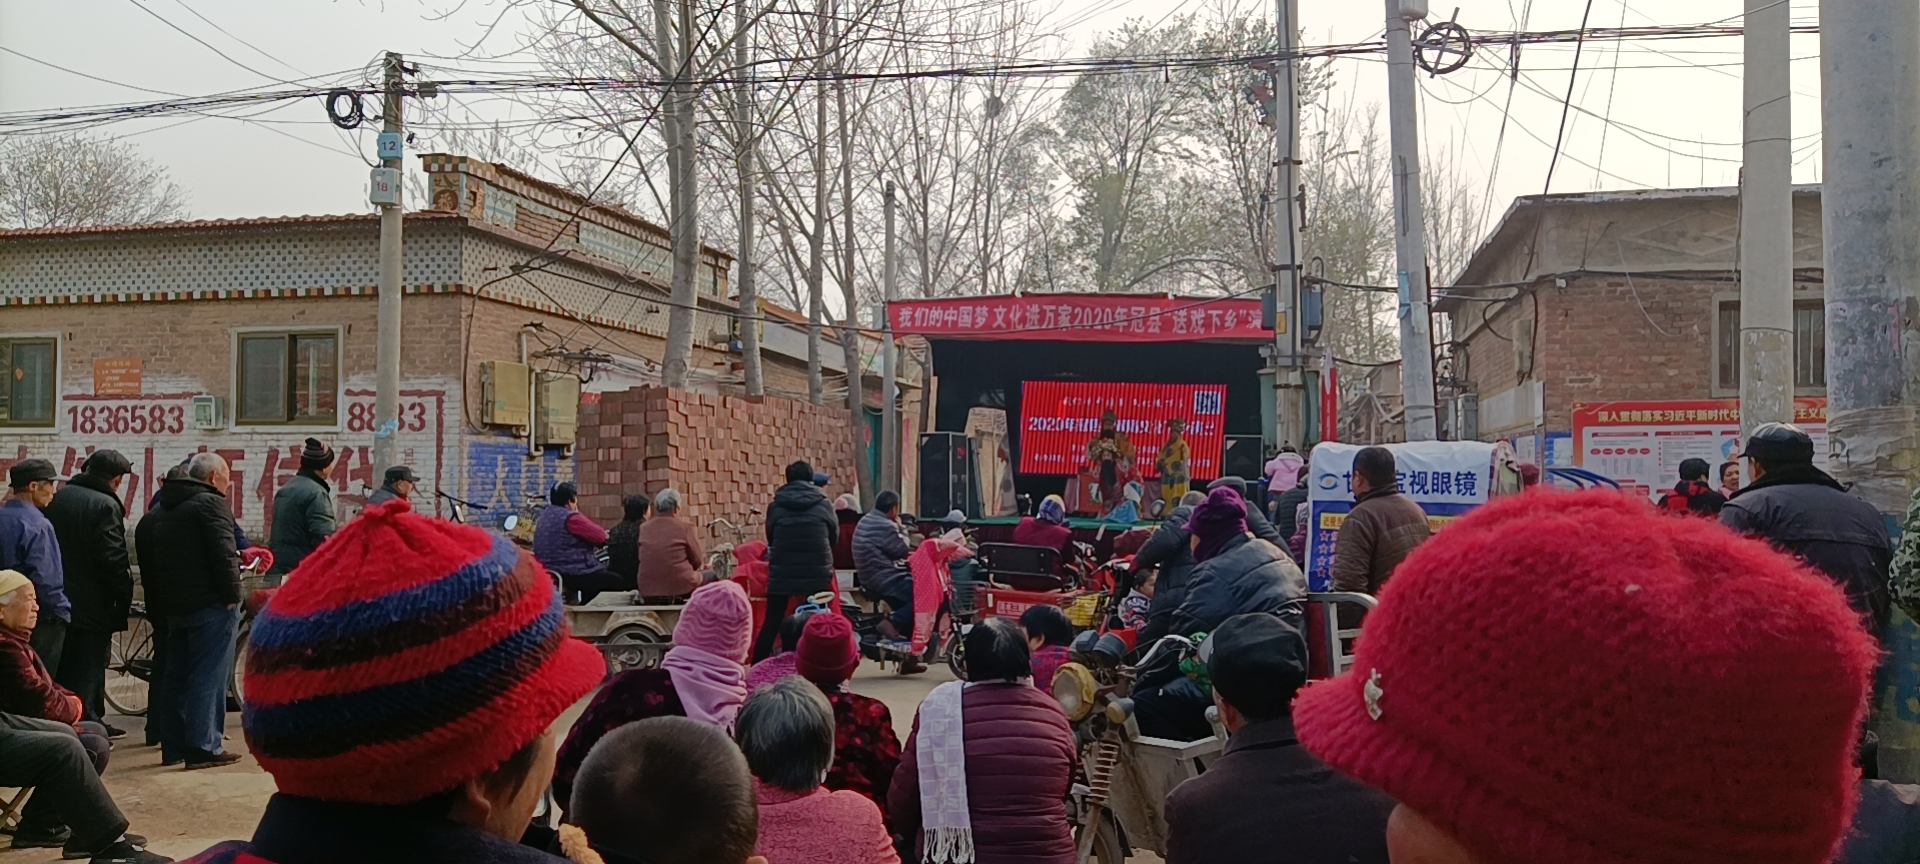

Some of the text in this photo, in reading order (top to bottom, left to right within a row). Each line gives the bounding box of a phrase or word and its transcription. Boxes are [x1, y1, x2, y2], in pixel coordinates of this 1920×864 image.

[381, 141, 396, 151] 12
[898, 305, 989, 329] 我们的中国梦
[67, 404, 184, 434] 1836583
[1342, 469, 1478, 497] 宝视眼镜
